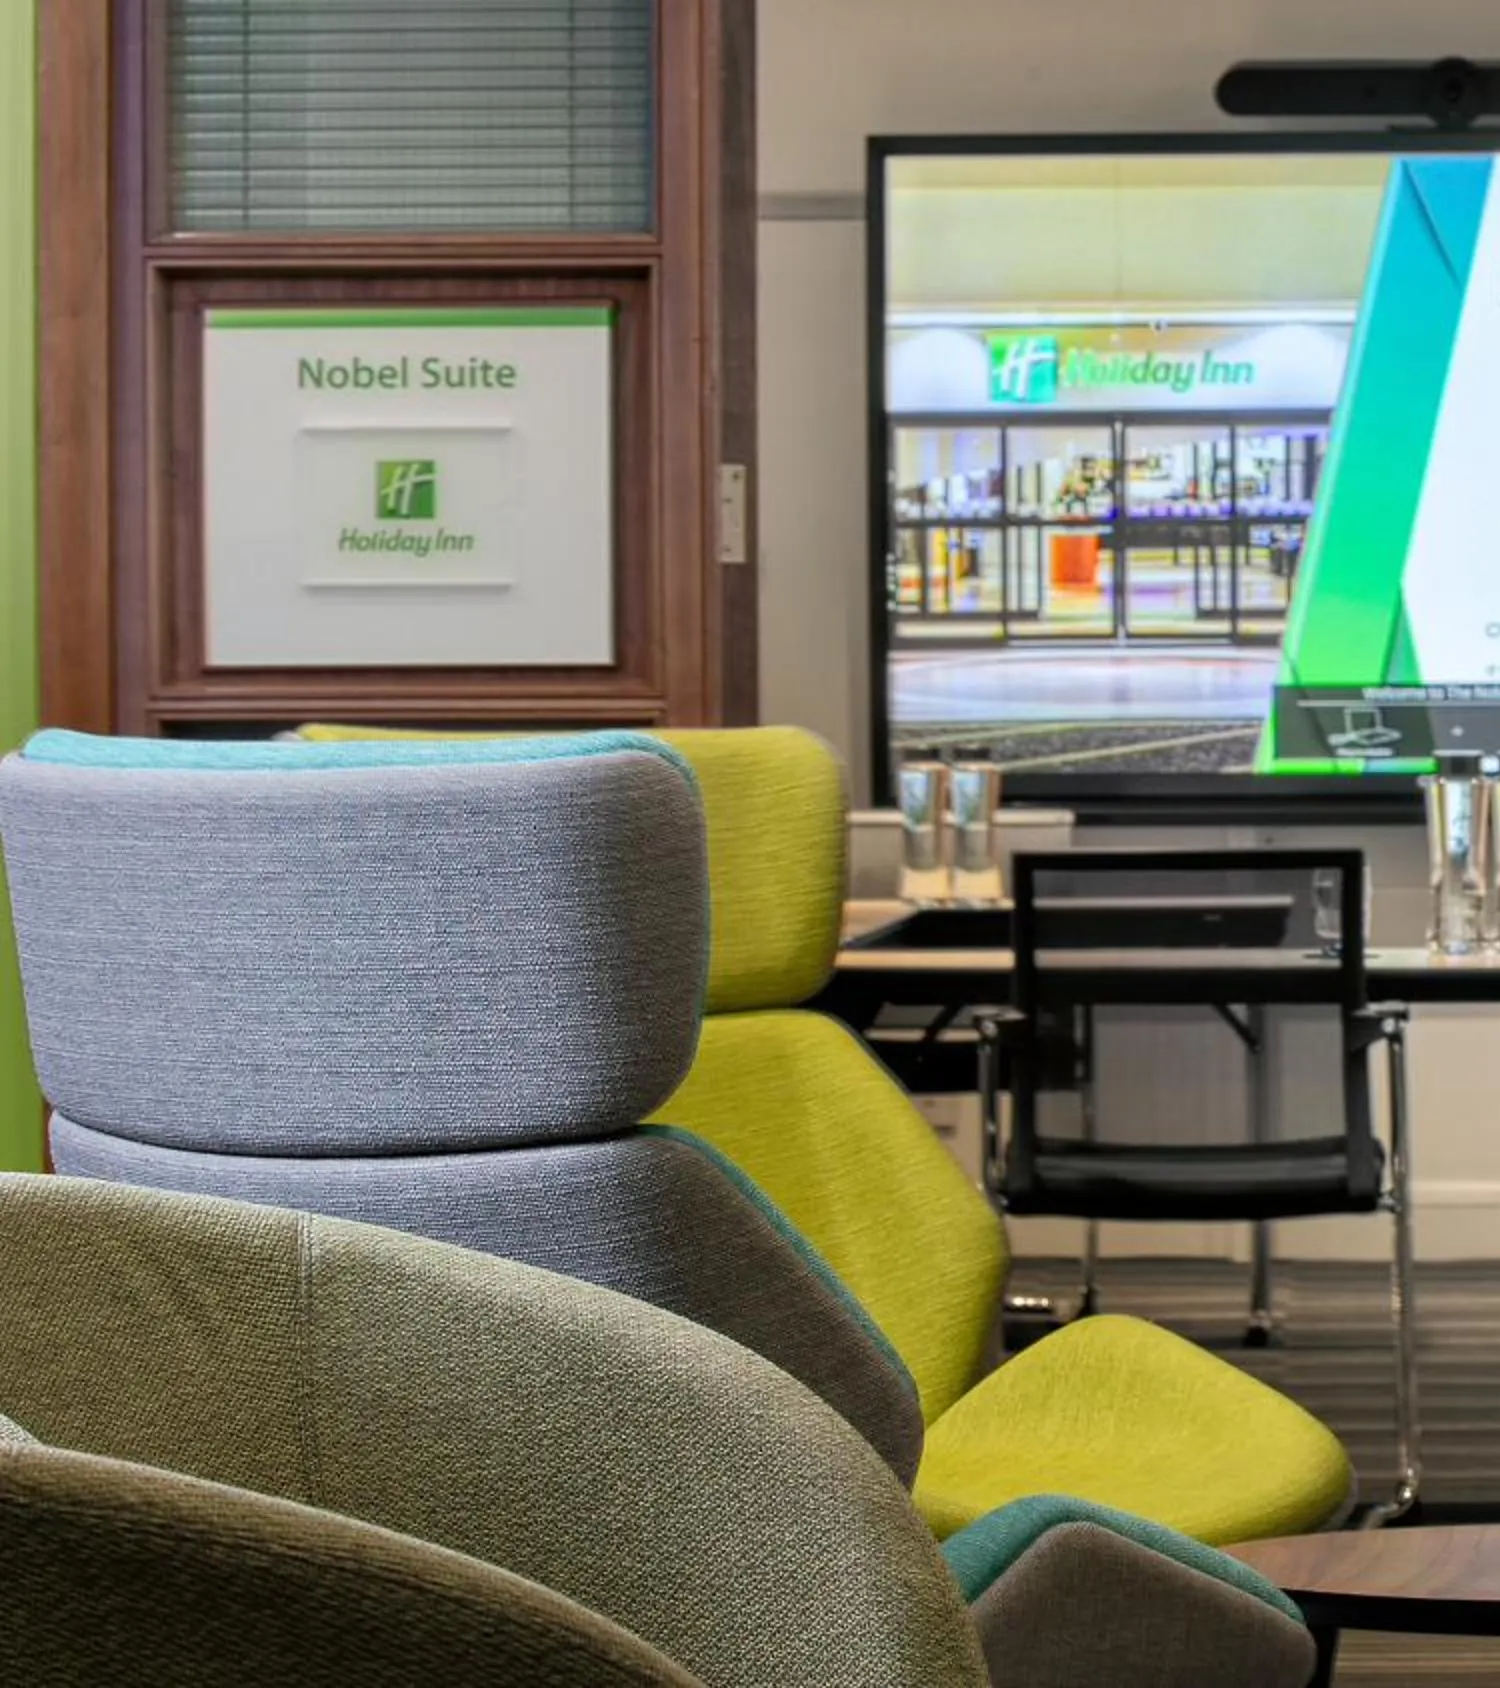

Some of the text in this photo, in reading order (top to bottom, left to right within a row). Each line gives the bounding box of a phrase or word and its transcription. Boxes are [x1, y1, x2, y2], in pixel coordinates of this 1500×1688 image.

[298, 357, 517, 389] Nobel Suite
[1065, 347, 1254, 391] Holiday Inn
[338, 528, 475, 557] Holiday Inn
